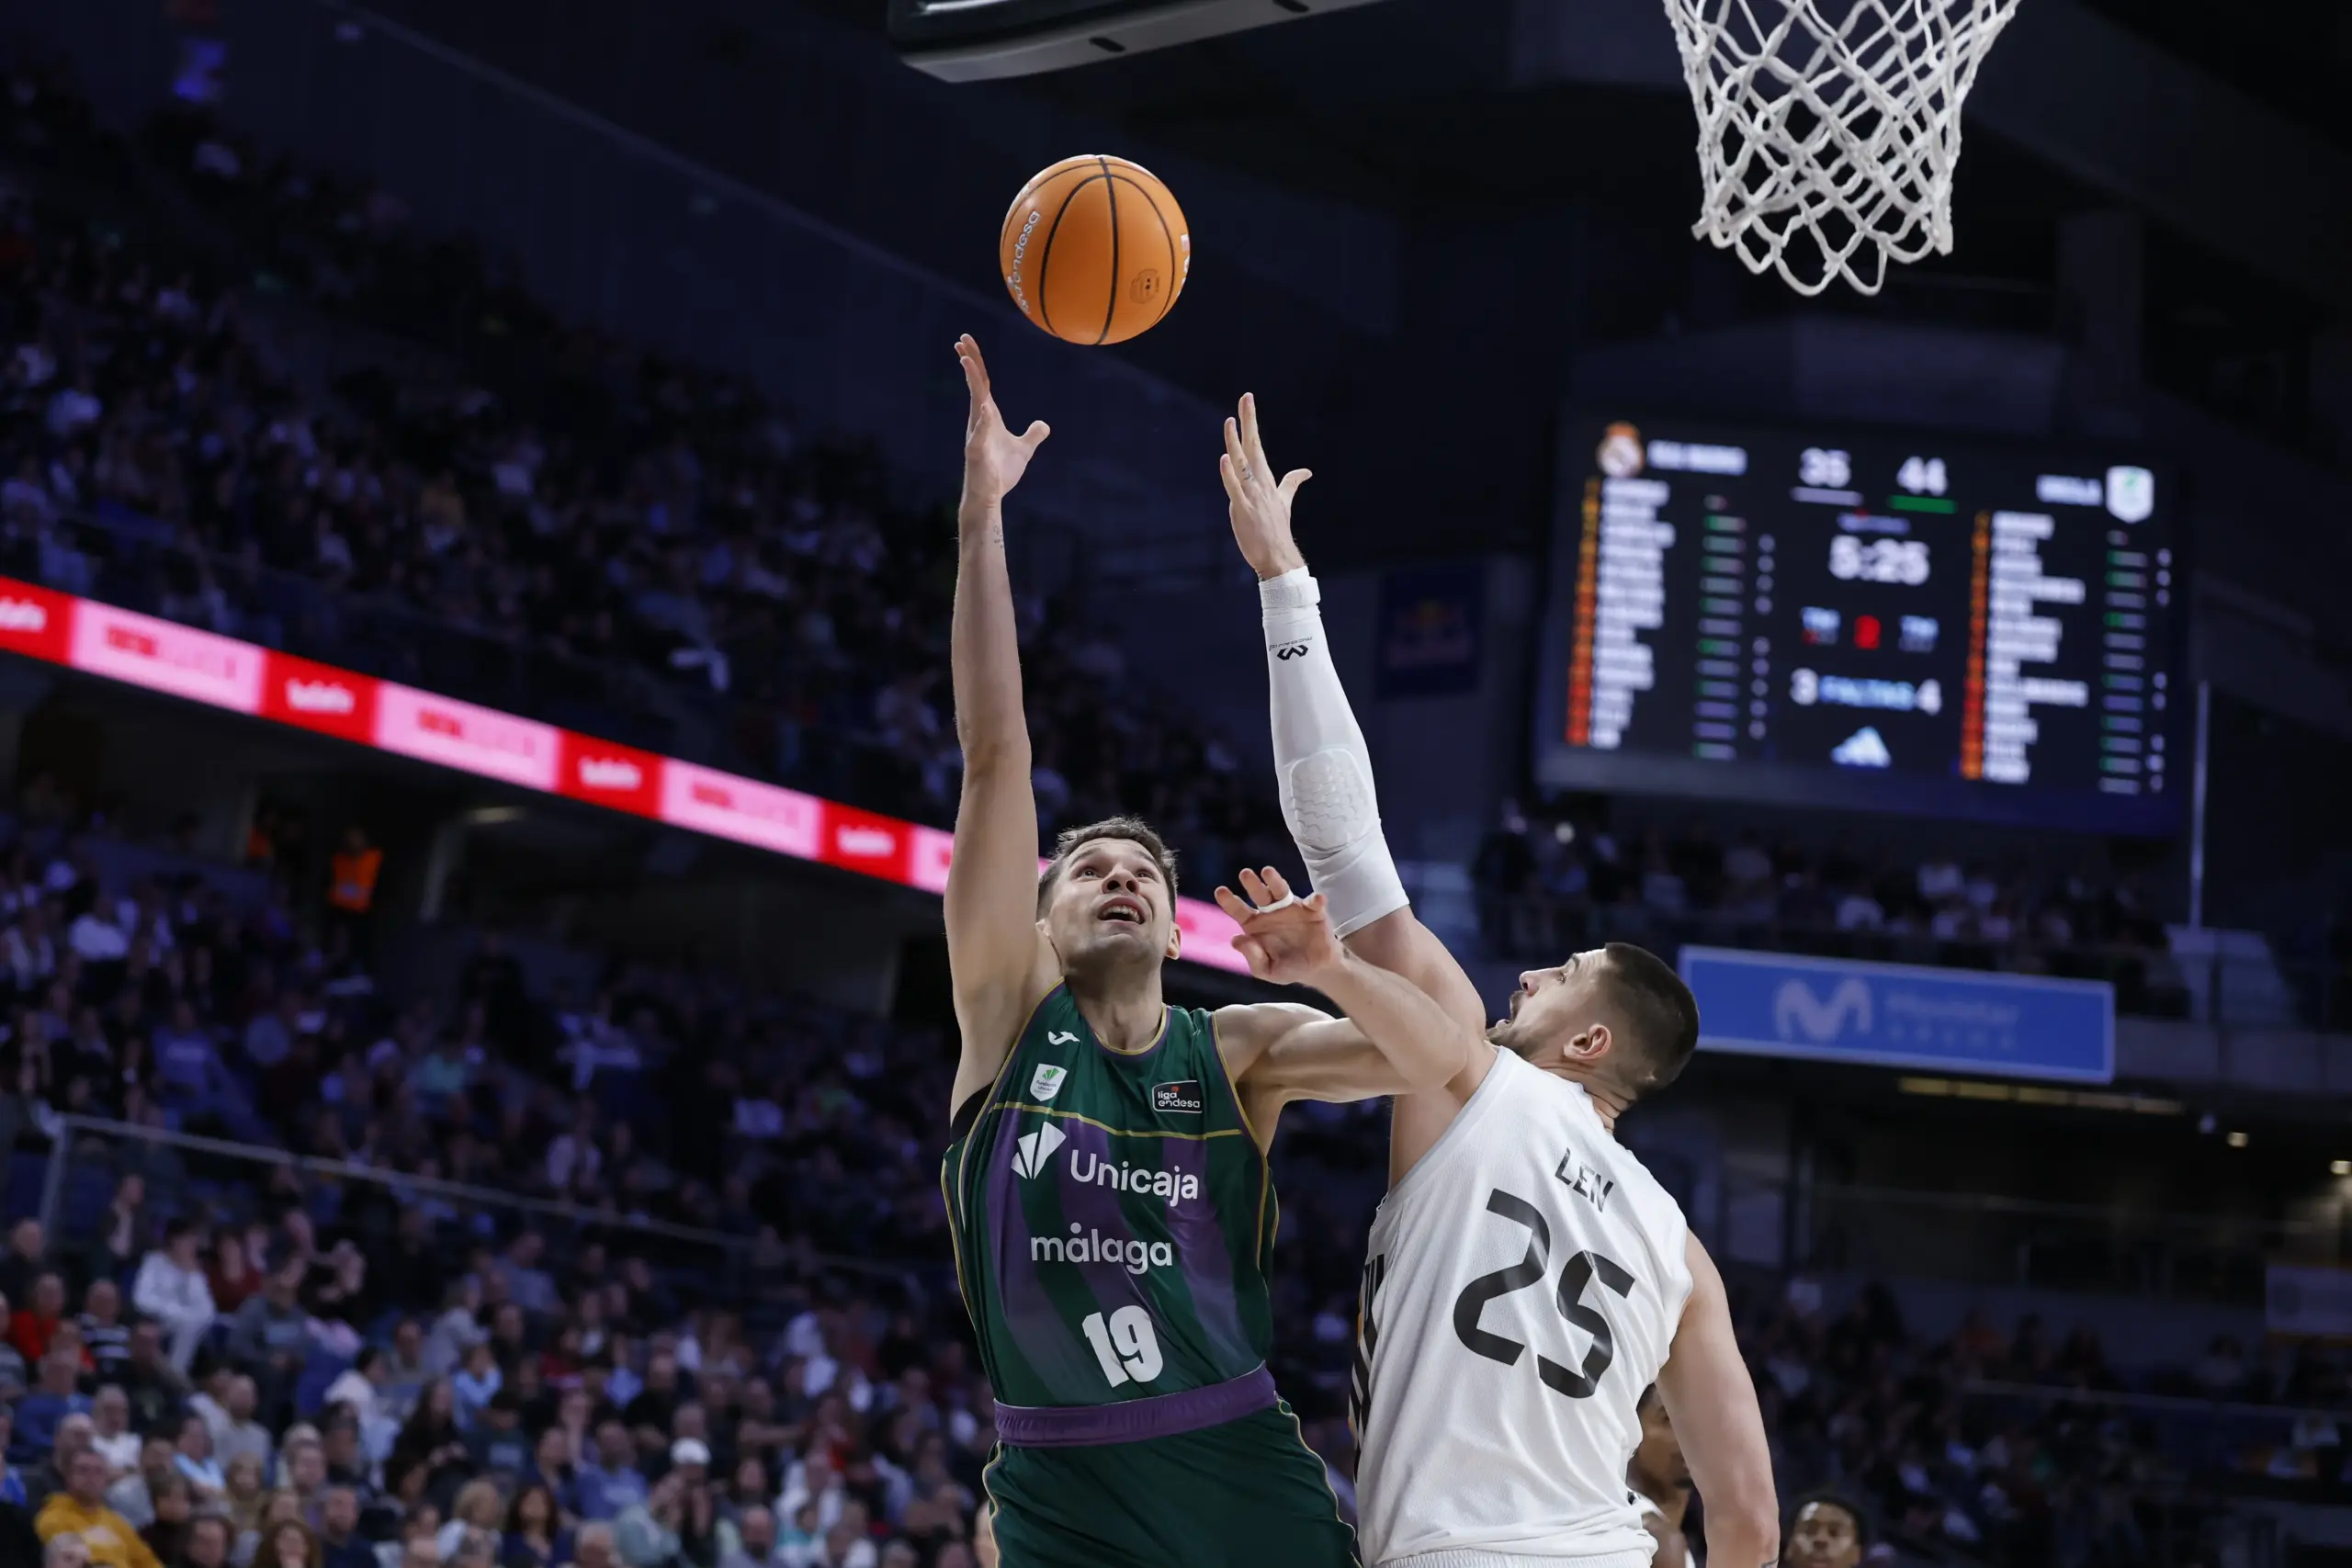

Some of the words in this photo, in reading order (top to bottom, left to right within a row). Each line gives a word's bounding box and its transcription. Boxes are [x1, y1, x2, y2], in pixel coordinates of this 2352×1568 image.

[1013, 210, 1040, 283] endesa
[1158, 1091, 1178, 1100] liga
[1158, 1099, 1201, 1109] endesa
[1070, 1149, 1199, 1208] Unicaja
[1555, 1147, 1614, 1213] LEN
[1453, 1188, 1635, 1399] 25
[1081, 1304, 1164, 1388] 19
